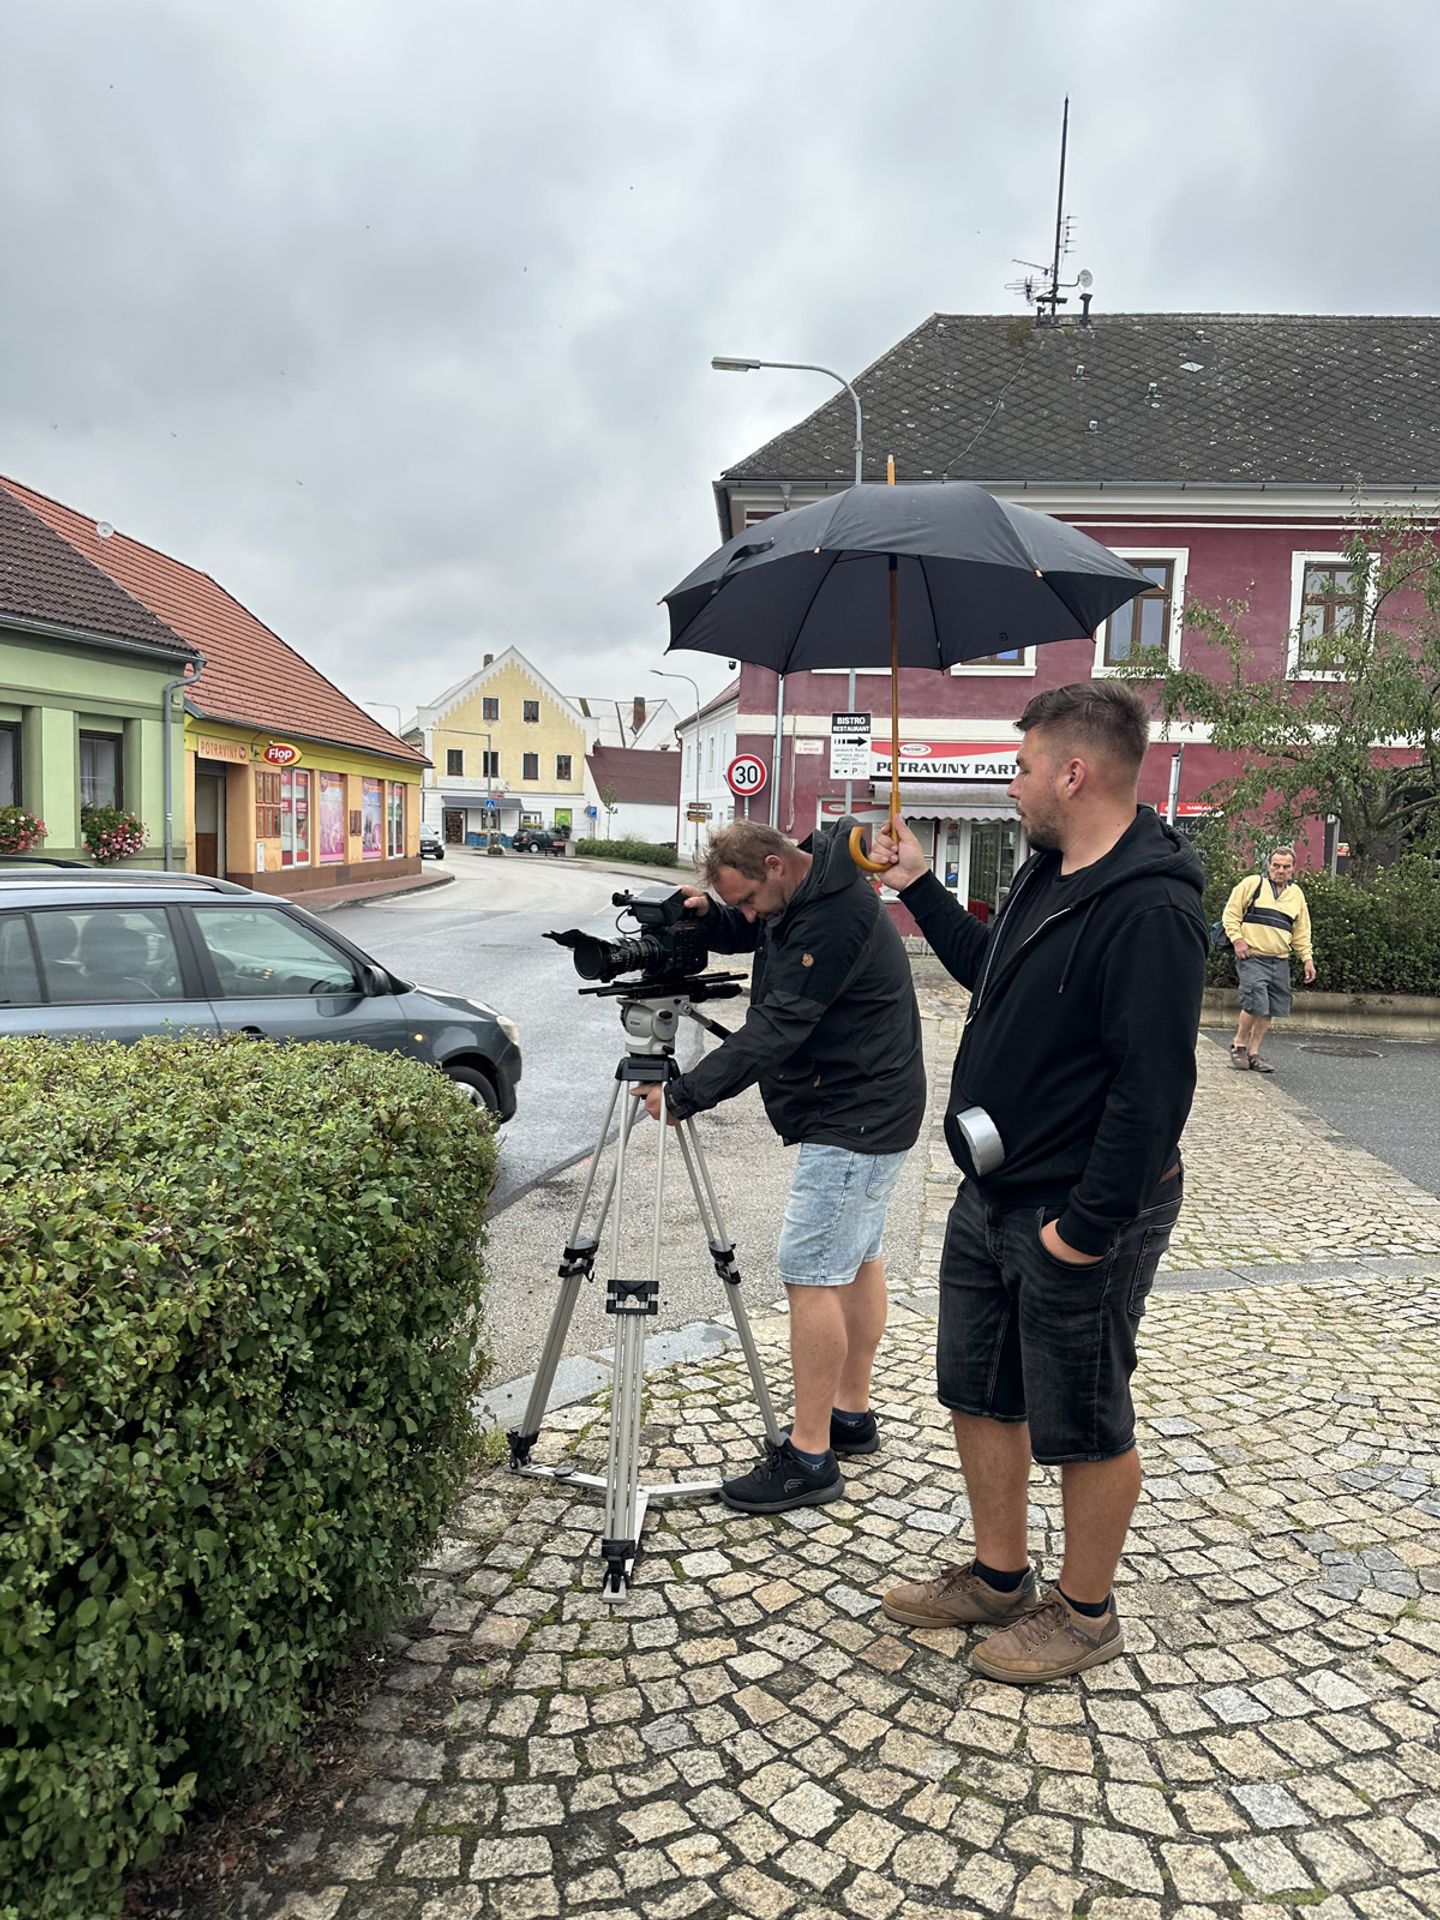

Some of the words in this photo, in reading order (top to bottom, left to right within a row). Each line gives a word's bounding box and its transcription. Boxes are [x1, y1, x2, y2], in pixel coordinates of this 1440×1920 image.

[836, 716, 866, 725] BISTRO
[200, 740, 238, 759] POTRAVINY
[268, 747, 293, 760] Flop
[735, 765, 758, 784] 30
